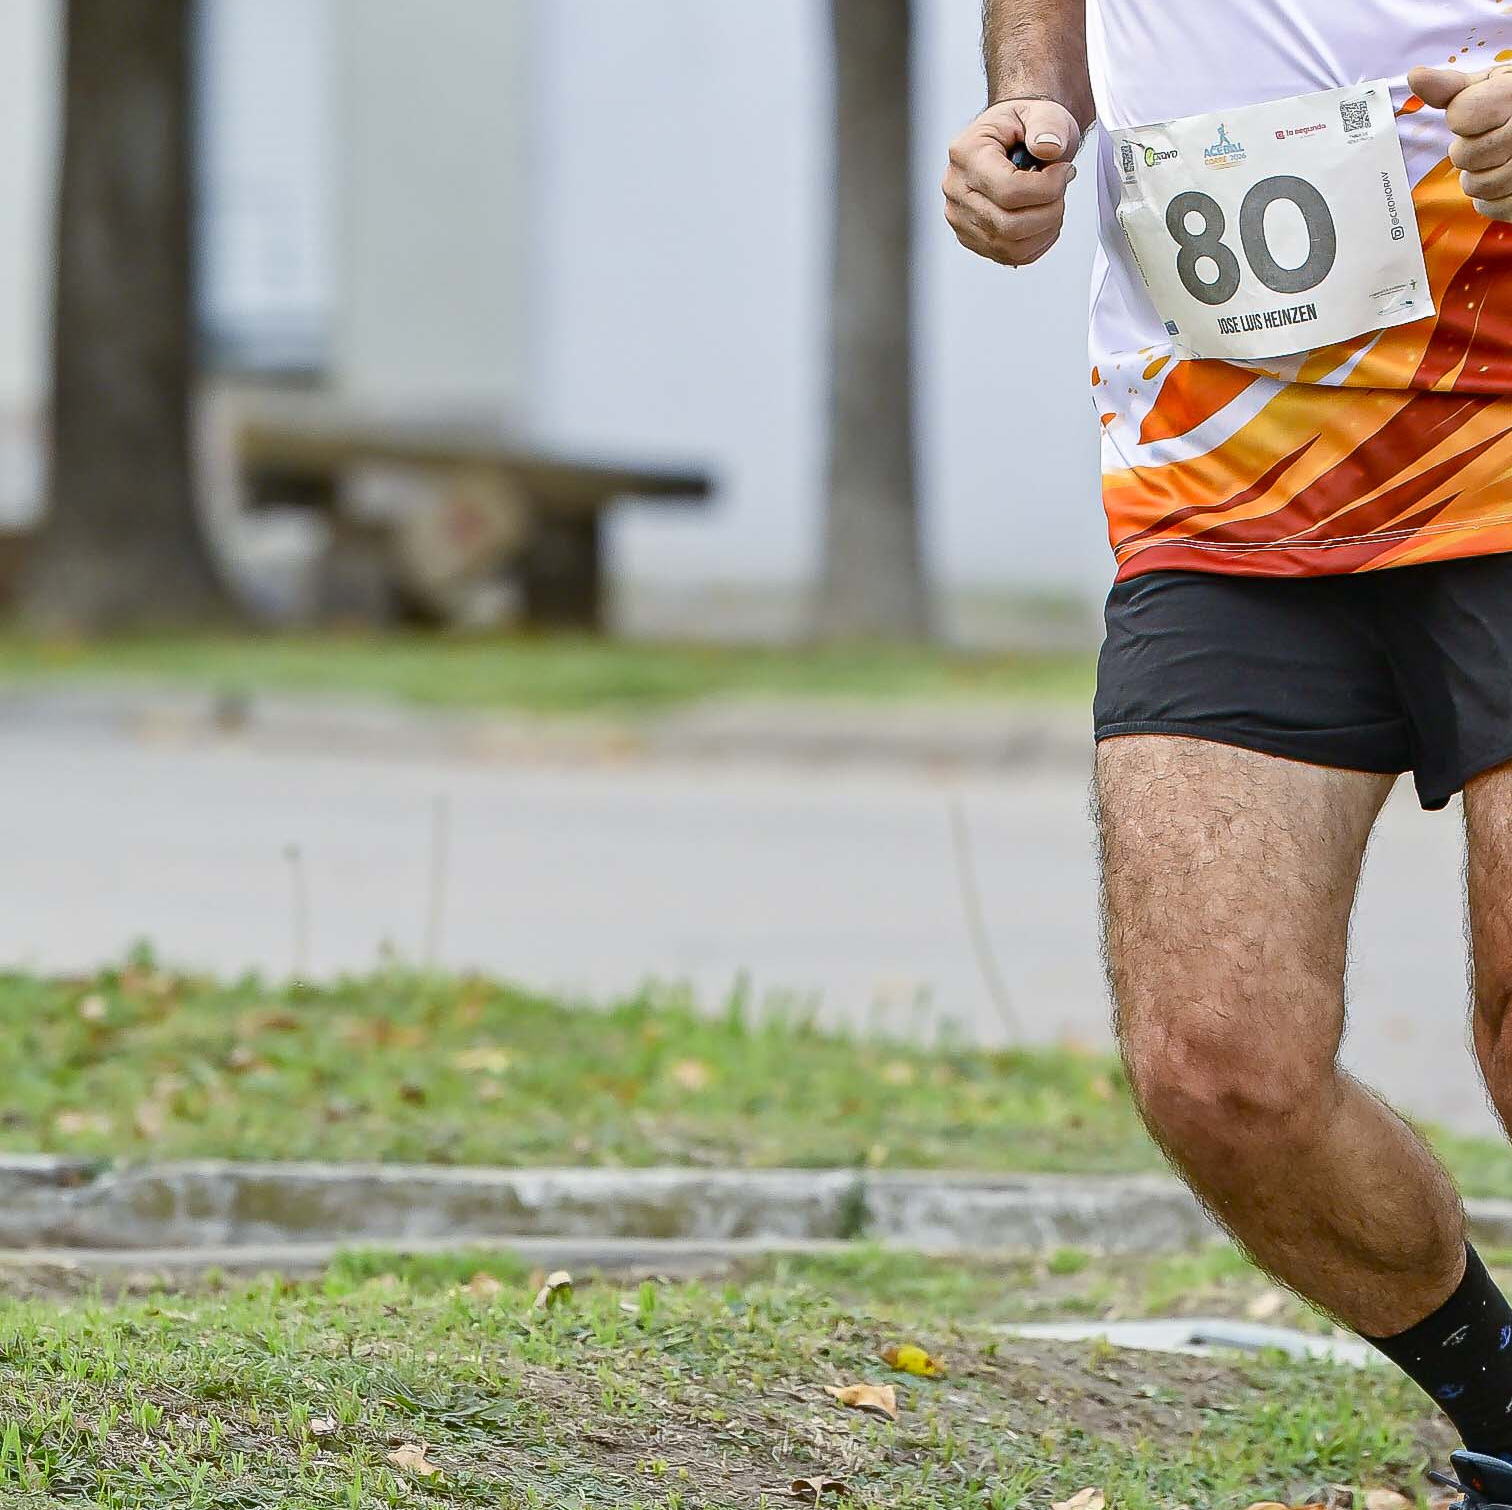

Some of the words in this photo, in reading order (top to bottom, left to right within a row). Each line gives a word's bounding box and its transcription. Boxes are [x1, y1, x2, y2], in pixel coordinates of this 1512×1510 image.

[1165, 175, 1337, 306] 80
[1217, 316, 1241, 335] JOSE
[1239, 313, 1263, 332] LUIS
[1263, 303, 1318, 329] HEINZEN
